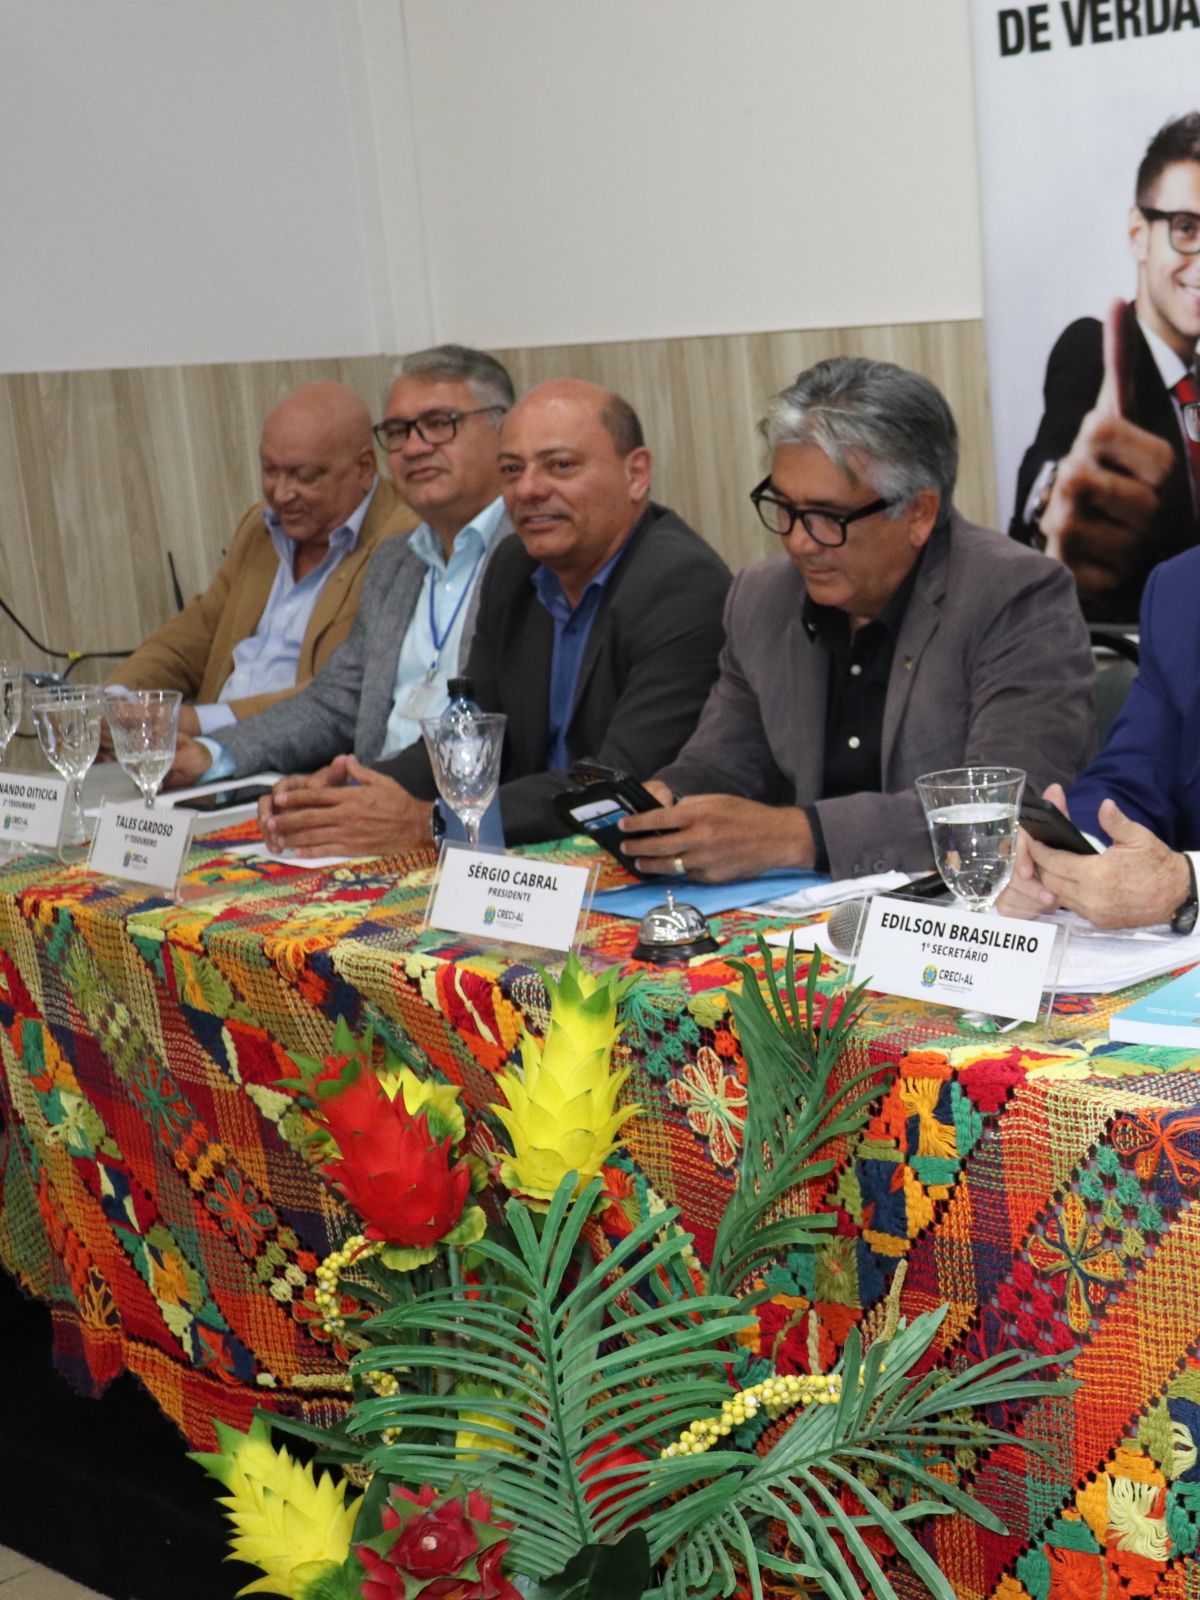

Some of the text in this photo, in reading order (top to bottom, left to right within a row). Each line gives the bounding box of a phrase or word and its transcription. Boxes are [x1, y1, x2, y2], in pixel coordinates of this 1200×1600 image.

[998, 4, 1052, 57] DE
[0, 782, 58, 801] NANDO OITICICA
[116, 815, 173, 837] TALES CARDOSO
[467, 861, 558, 891] SÉRGIO CABRAL
[488, 887, 531, 902] PRESIDENTE
[497, 909, 524, 922] CRECI-AL
[881, 912, 1039, 953] EDILSON BRASILEIRO
[931, 943, 989, 963] SECRETÁRIO
[939, 969, 974, 985] CRECI-AL
